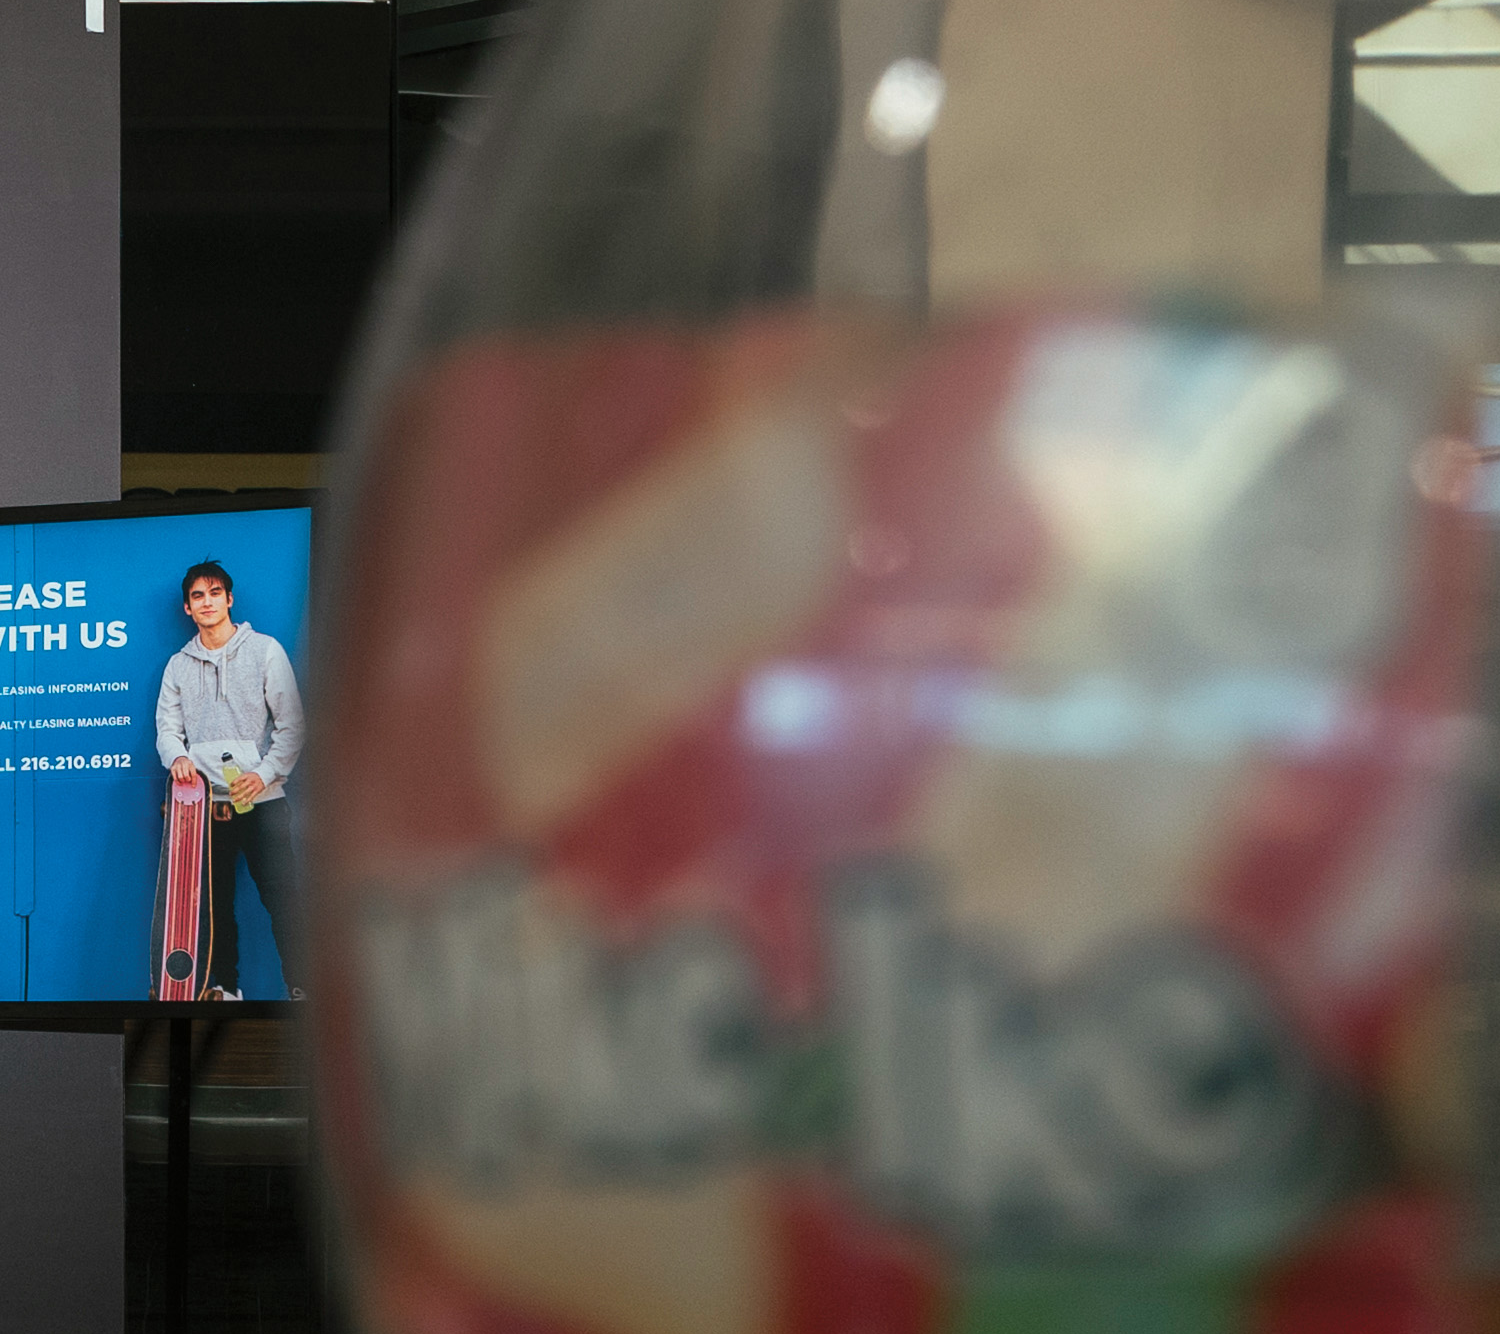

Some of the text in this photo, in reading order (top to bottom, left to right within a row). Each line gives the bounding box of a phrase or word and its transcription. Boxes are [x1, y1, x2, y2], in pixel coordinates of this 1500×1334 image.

[79, 620, 128, 649] US
[48, 681, 129, 694] INFORMATION
[29, 717, 75, 729] LEASING
[77, 716, 132, 728] MANAGER
[20, 753, 132, 771] 216.210.6912
